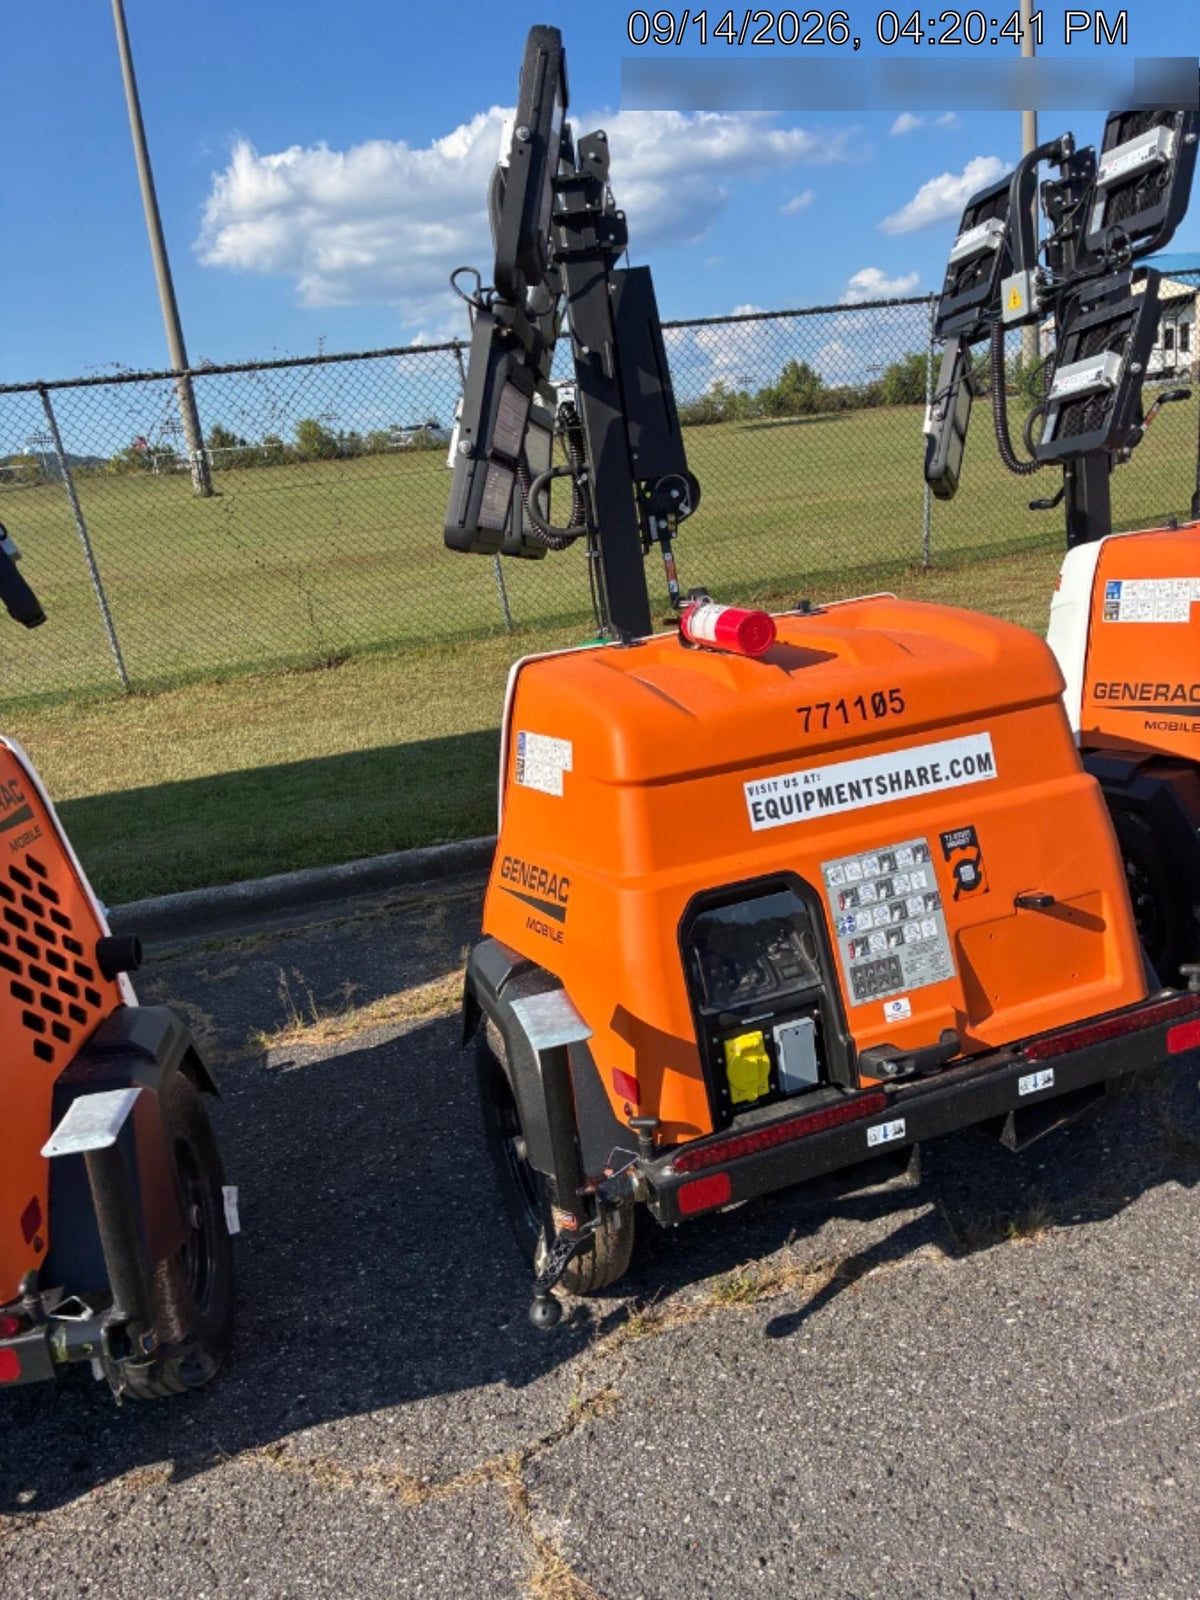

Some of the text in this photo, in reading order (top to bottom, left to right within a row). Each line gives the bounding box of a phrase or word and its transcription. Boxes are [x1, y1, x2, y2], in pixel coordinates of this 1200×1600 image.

[797, 688, 905, 733] 771105
[1144, 720, 1200, 733] MOBILE
[747, 773, 821, 797] VISIT US AT:
[752, 751, 993, 823] EQUIPMENTSHARE.COM
[501, 855, 570, 904] GENERAC
[526, 916, 564, 944] MOBILE
